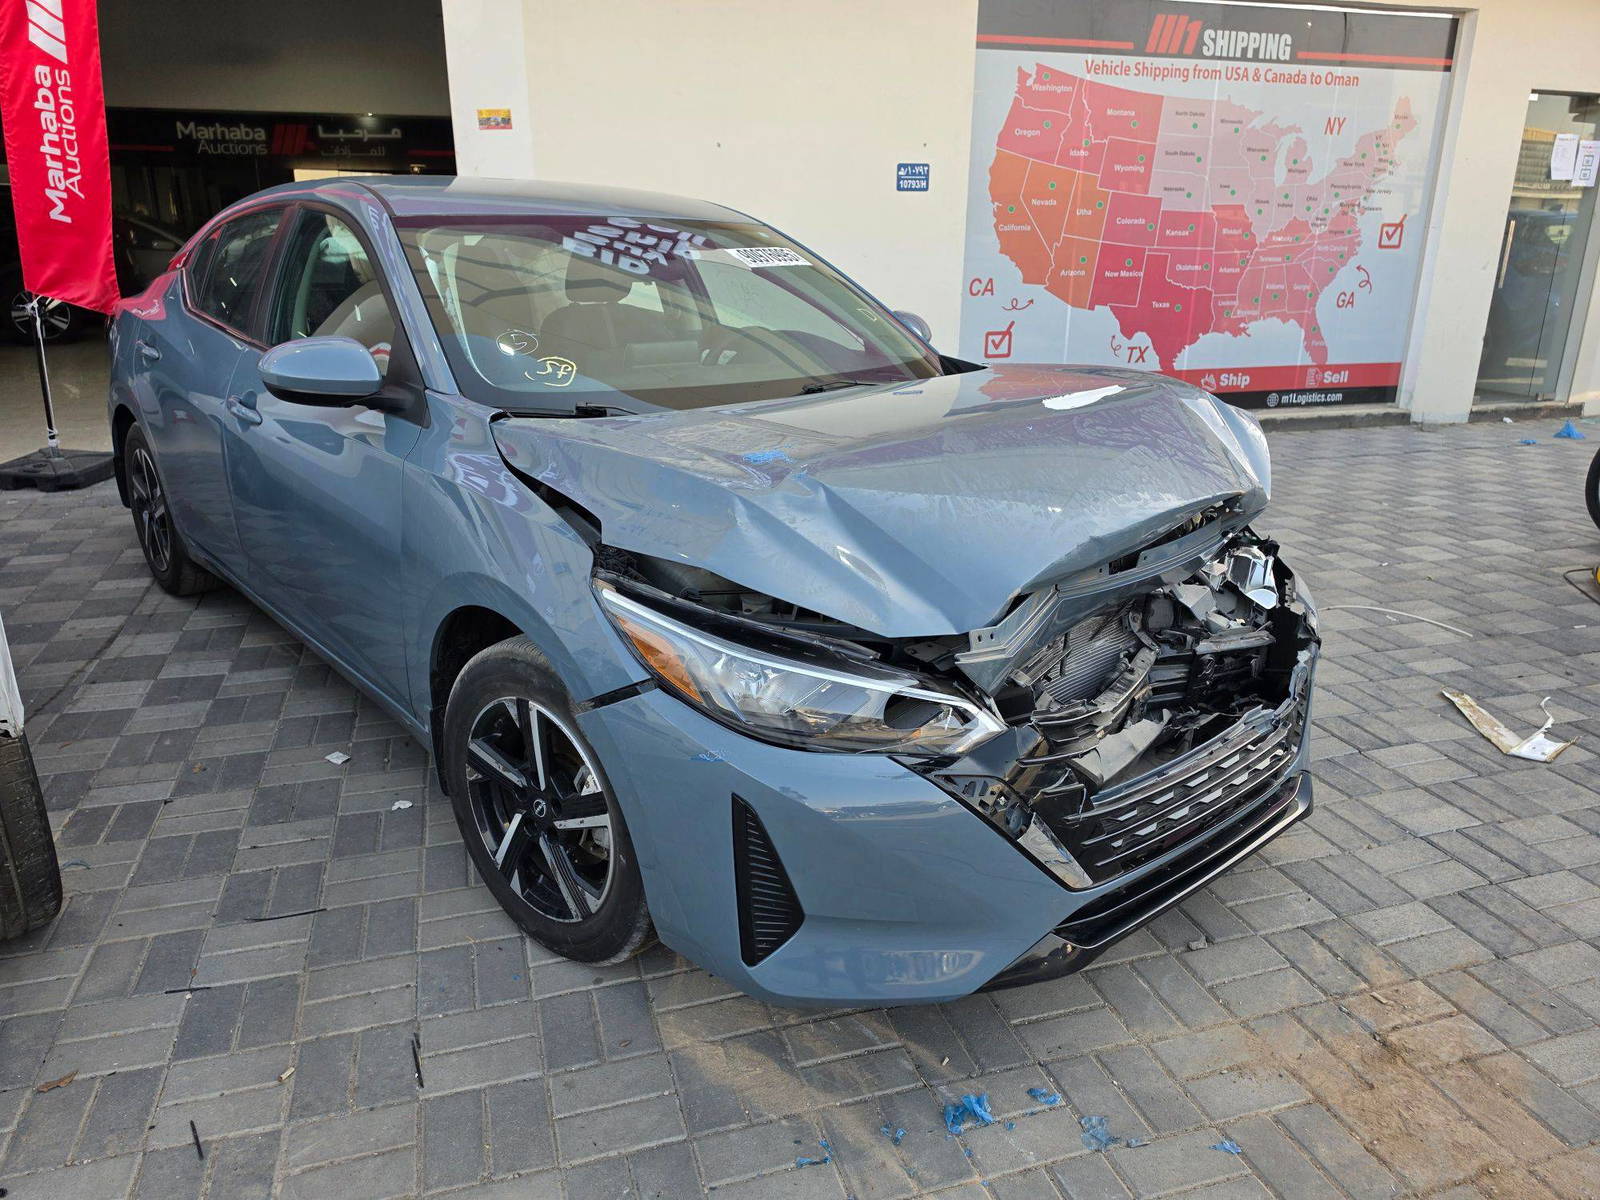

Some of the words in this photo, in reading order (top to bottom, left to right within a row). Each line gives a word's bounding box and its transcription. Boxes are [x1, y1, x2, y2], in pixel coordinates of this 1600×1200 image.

[1202, 29, 1292, 61] SHIPPING
[1085, 60, 1130, 76] Vehicle
[1134, 62, 1190, 82] Shipping
[1193, 64, 1222, 80] from
[1225, 66, 1249, 82] USA
[1251, 66, 1262, 82] &
[1264, 67, 1307, 85] Canada
[1310, 71, 1322, 85] to
[1325, 72, 1360, 87] Oman
[1032, 84, 1073, 93] Washington
[1106, 108, 1135, 116] Montana
[176, 121, 266, 140] Marhaba
[1014, 128, 1041, 138] Oregon
[1324, 117, 1347, 135] NY
[55, 69, 85, 199] Auctions
[34, 65, 72, 223] Marhaba
[197, 140, 268, 155] Auctions
[1069, 149, 1089, 157] Idaho
[1114, 164, 1145, 173] Wyoming
[1031, 198, 1057, 206] Nevada
[998, 224, 1032, 232] California
[1060, 269, 1086, 277] Arizona
[969, 277, 994, 297] CA
[1336, 291, 1355, 309] GA
[1126, 345, 1150, 364] TX
[1219, 372, 1251, 388] Ship
[1322, 370, 1349, 384] Sell
[1281, 391, 1343, 404] m1Logistics.com
